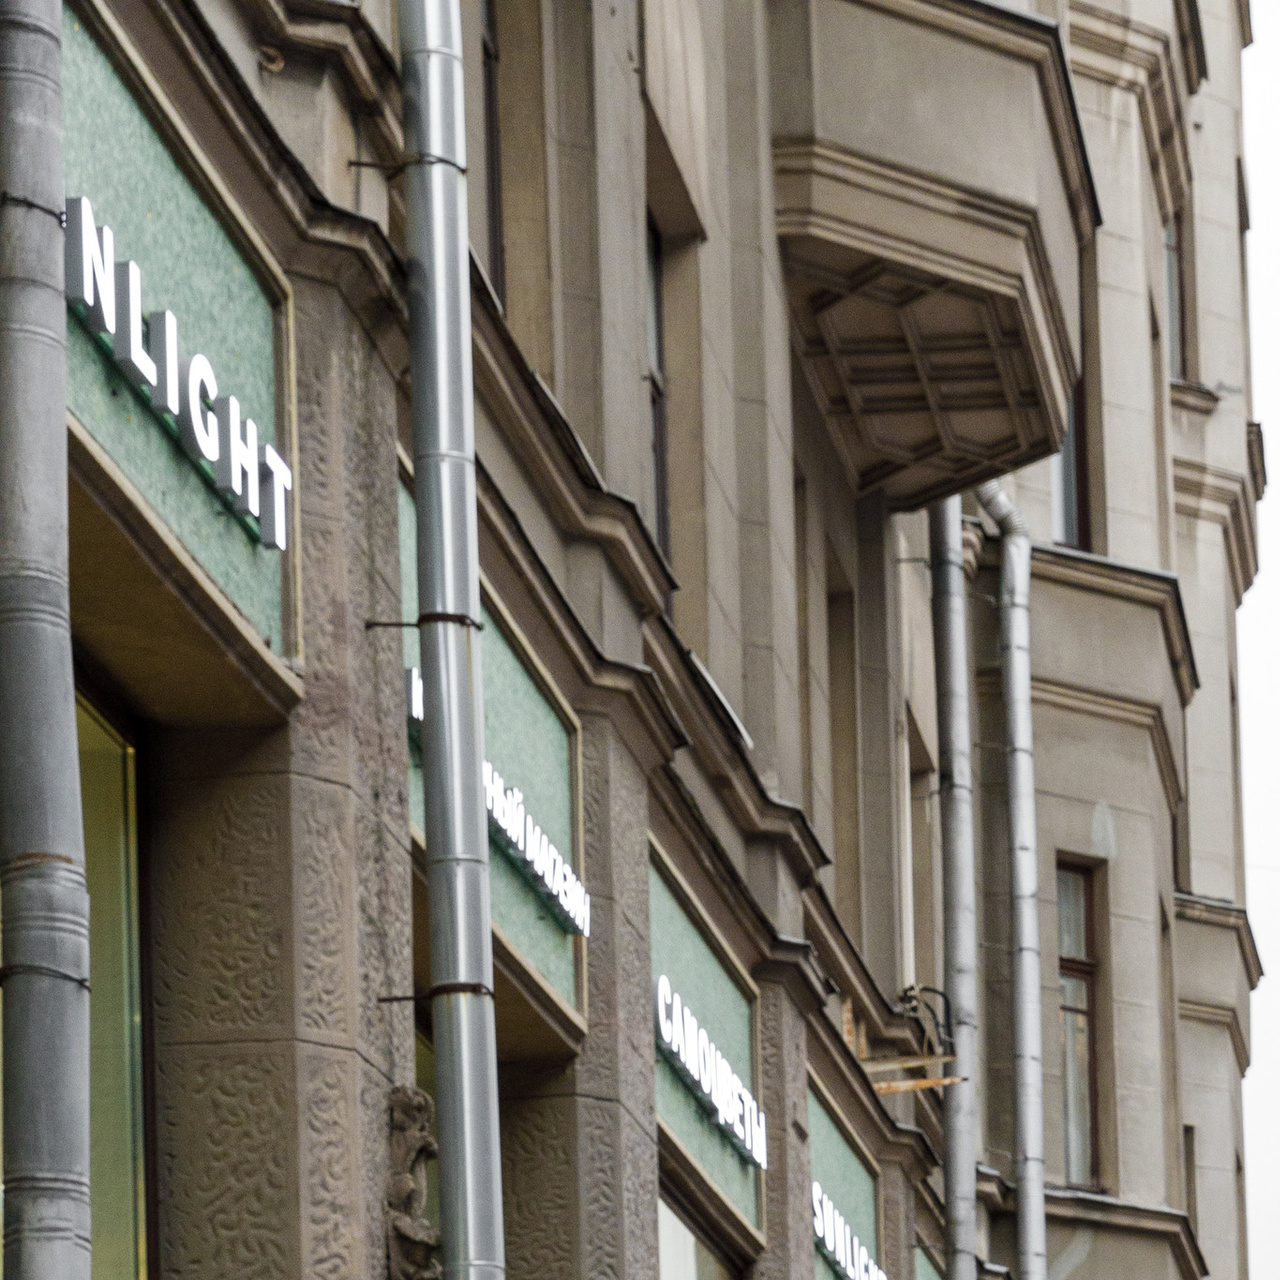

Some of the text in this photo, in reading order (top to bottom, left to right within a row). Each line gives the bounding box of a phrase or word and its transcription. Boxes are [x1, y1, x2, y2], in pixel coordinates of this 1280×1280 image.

[80, 196, 292, 551] NLIGHT
[525, 814, 591, 938] МАГАЗИН
[658, 974, 767, 1170] САМОЦВЕТЫ
